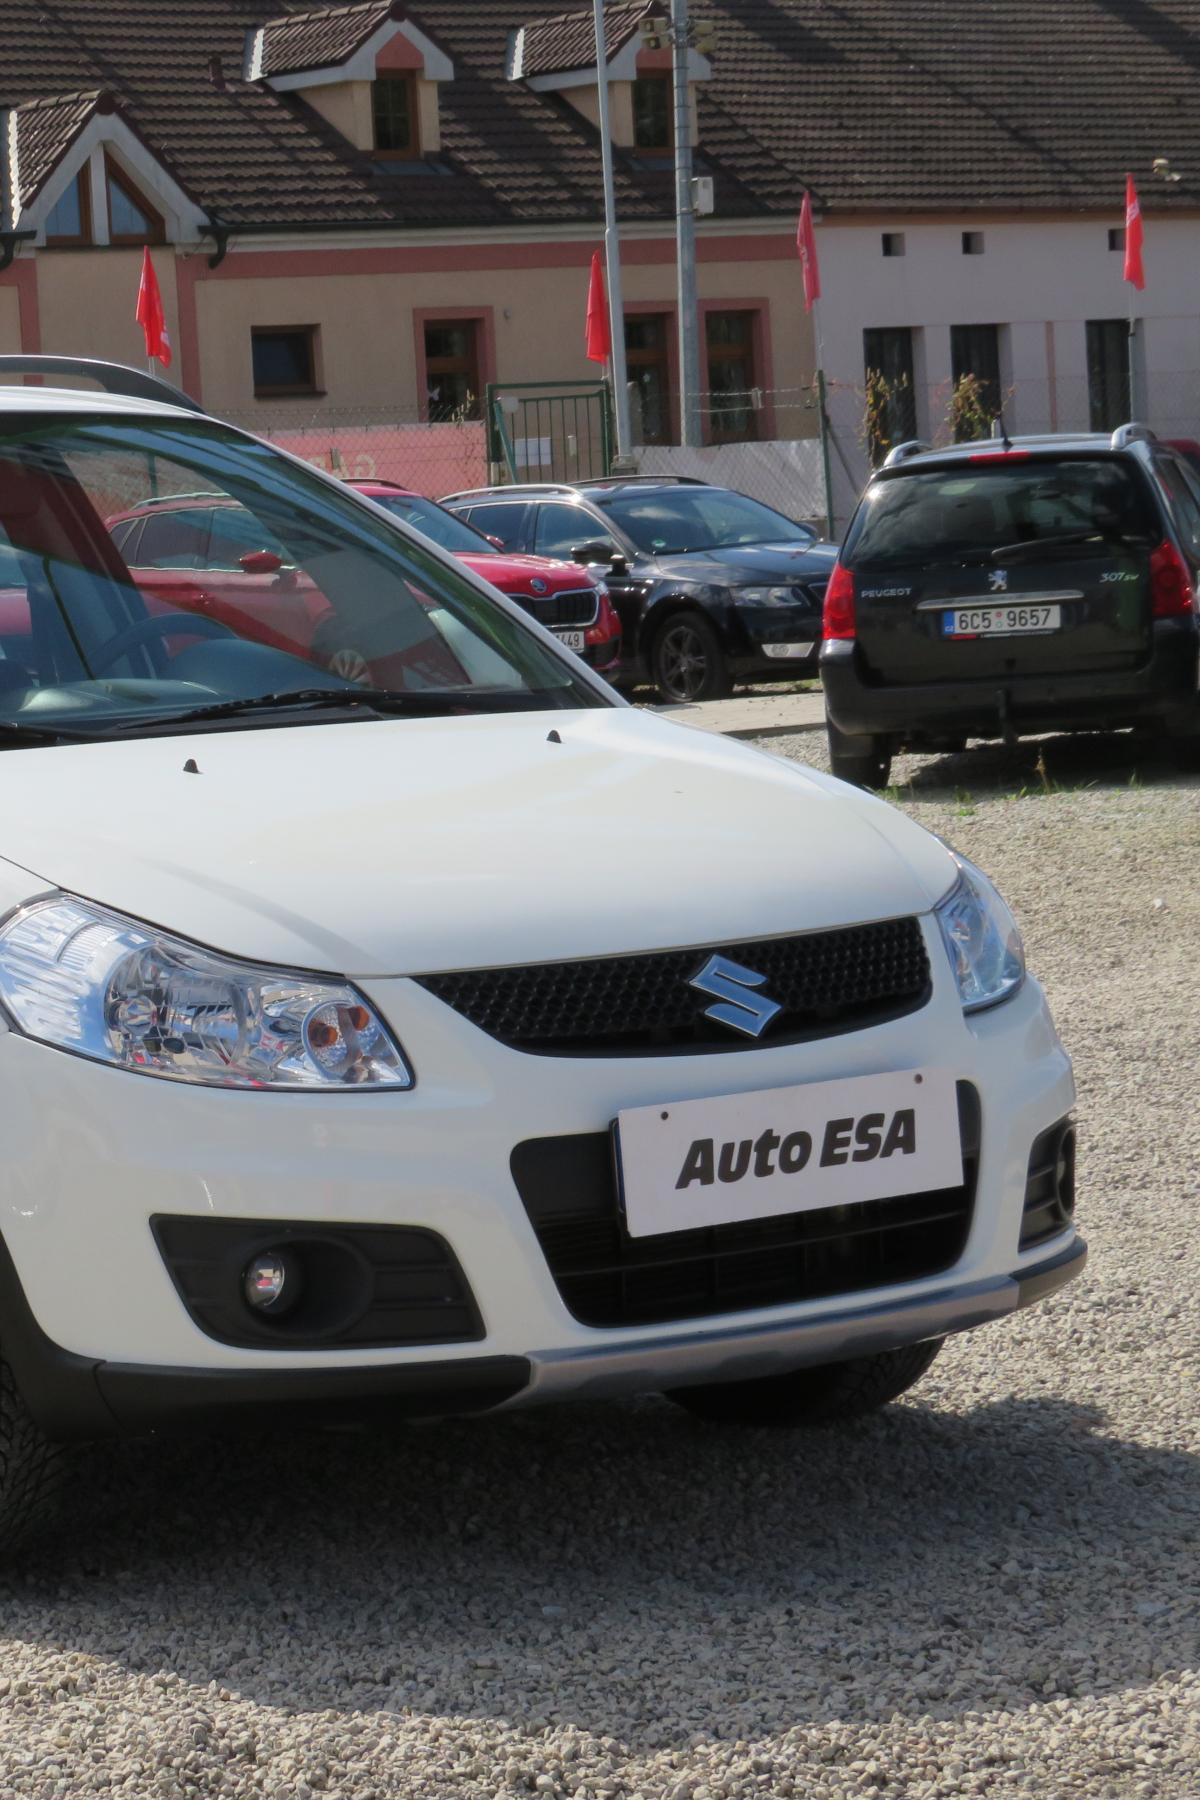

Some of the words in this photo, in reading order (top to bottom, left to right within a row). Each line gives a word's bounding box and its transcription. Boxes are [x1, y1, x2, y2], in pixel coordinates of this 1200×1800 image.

[860, 587, 912, 598] PEUGEOT
[959, 611, 992, 630] 6C5
[1006, 607, 1051, 628] 9657
[674, 1128, 813, 1190] Auto
[819, 1108, 916, 1168] ESA
